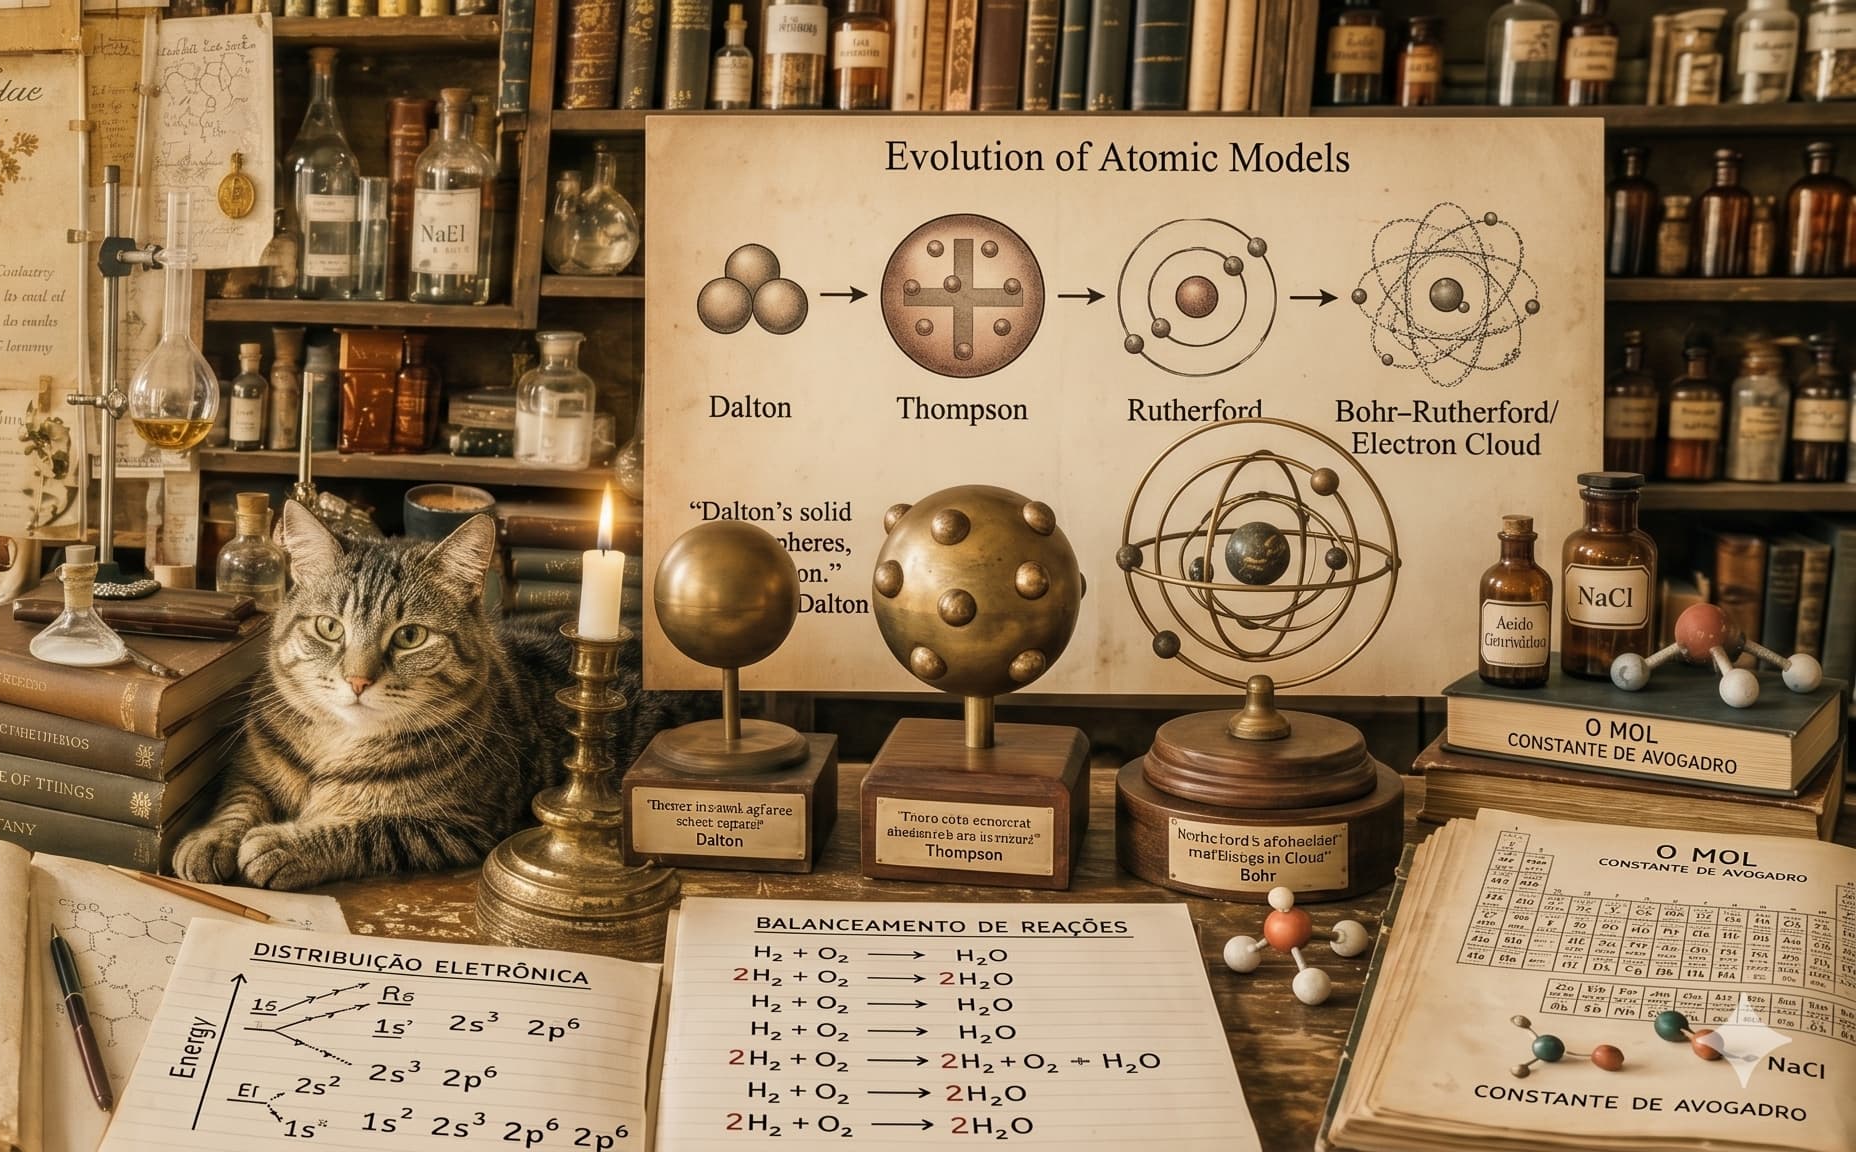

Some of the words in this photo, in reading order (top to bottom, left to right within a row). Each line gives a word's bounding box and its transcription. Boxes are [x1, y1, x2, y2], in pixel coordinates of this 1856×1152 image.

[884, 140, 1044, 172] Evolution
[1055, 140, 1094, 172] of
[1098, 140, 1218, 173] Atomic
[1228, 141, 1350, 173] Models
[709, 395, 792, 418] Dalton
[896, 396, 1029, 426] Thompson
[1127, 398, 1263, 422] Rutherford
[1351, 431, 1457, 456] Electron
[1464, 431, 1542, 456] Cloud
[800, 501, 852, 522] solid
[776, 532, 852, 557] pheres,
[797, 594, 870, 614] Dalton
[1578, 585, 1633, 608] NaCl
[1586, 718, 1601, 737] O
[1610, 720, 1658, 744] MOL
[1508, 732, 1607, 759] CONSTANTE
[1614, 745, 1636, 762] DE
[1642, 749, 1737, 775] AVOGADRO
[10, 772, 31, 787] OF
[696, 833, 744, 848] Dalton
[925, 843, 1003, 863] Thompson
[1267, 851, 1281, 864] in
[1656, 844, 1677, 859] O
[1692, 847, 1757, 867] MOL
[1240, 868, 1277, 882] Bohr
[1599, 858, 1689, 873] CONSTANTE
[1697, 867, 1716, 875] DE
[1722, 869, 1808, 882] AVOGADRO
[756, 917, 966, 933] BALANCEAMENTO
[978, 920, 1008, 933] DE
[1021, 918, 1128, 936] REAÇÕES
[253, 942, 423, 972] DISTRIBUIÇÃO
[435, 959, 589, 985] ELETRÔNICA
[169, 1016, 217, 1079] Energy
[1768, 1056, 1825, 1079] NaCl
[1474, 1084, 1618, 1110] CONSTANTE
[1632, 1097, 1663, 1111] DE
[1674, 1099, 1807, 1122] AVOGADRO
